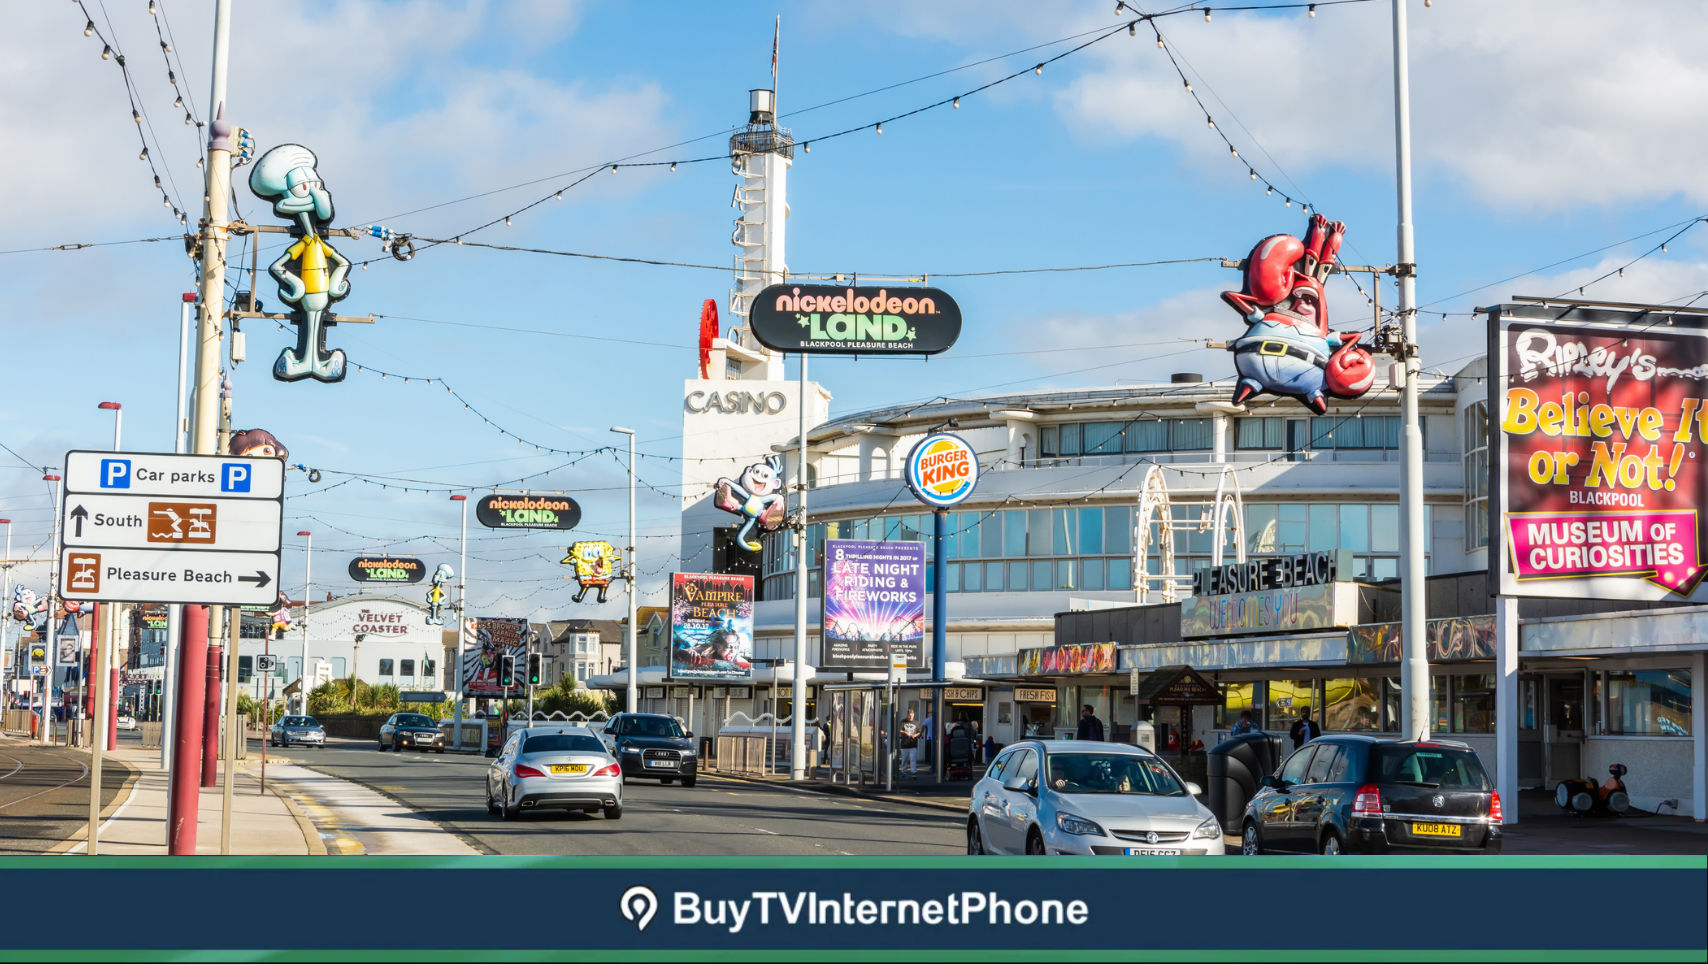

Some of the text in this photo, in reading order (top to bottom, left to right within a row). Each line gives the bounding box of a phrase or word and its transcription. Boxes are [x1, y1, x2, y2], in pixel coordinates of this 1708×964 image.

[776, 287, 936, 314] nickelodeon
[800, 340, 846, 348] BLACKPOOL
[847, 341, 886, 349] PLEASURE
[686, 390, 787, 415] CASINO
[1502, 387, 1664, 441] Believe
[920, 450, 968, 470] BURGER
[1528, 441, 1685, 492] or Not!
[136, 468, 165, 481] Car
[170, 470, 216, 484] parks
[922, 461, 970, 487] KING
[489, 496, 569, 510] nickelodeon
[1569, 490, 1645, 507] BLACKPOOL
[94, 514, 143, 528] South
[1528, 520, 1676, 545] MUSEUM OF
[835, 549, 844, 560] 8
[1529, 542, 1684, 570] CURIOSITIES
[358, 558, 417, 569] nickelodeon
[834, 563, 919, 576] LATE NIGHT
[107, 567, 232, 583] Pleasure Beach
[1193, 551, 1337, 597] PLEASURE BEACH
[845, 576, 909, 588] RIDING &
[836, 590, 917, 603] FIREWORKS
[358, 614, 403, 623] VELVET
[693, 606, 736, 618] BEACH
[1209, 593, 1298, 630] WELCOMES YOU
[353, 624, 408, 634] COASTER
[493, 637, 518, 647] MAGIC
[959, 689, 978, 699] CHIPS
[1019, 690, 1054, 700] FRESH FISH
[1416, 823, 1457, 834] KU08 ATZ
